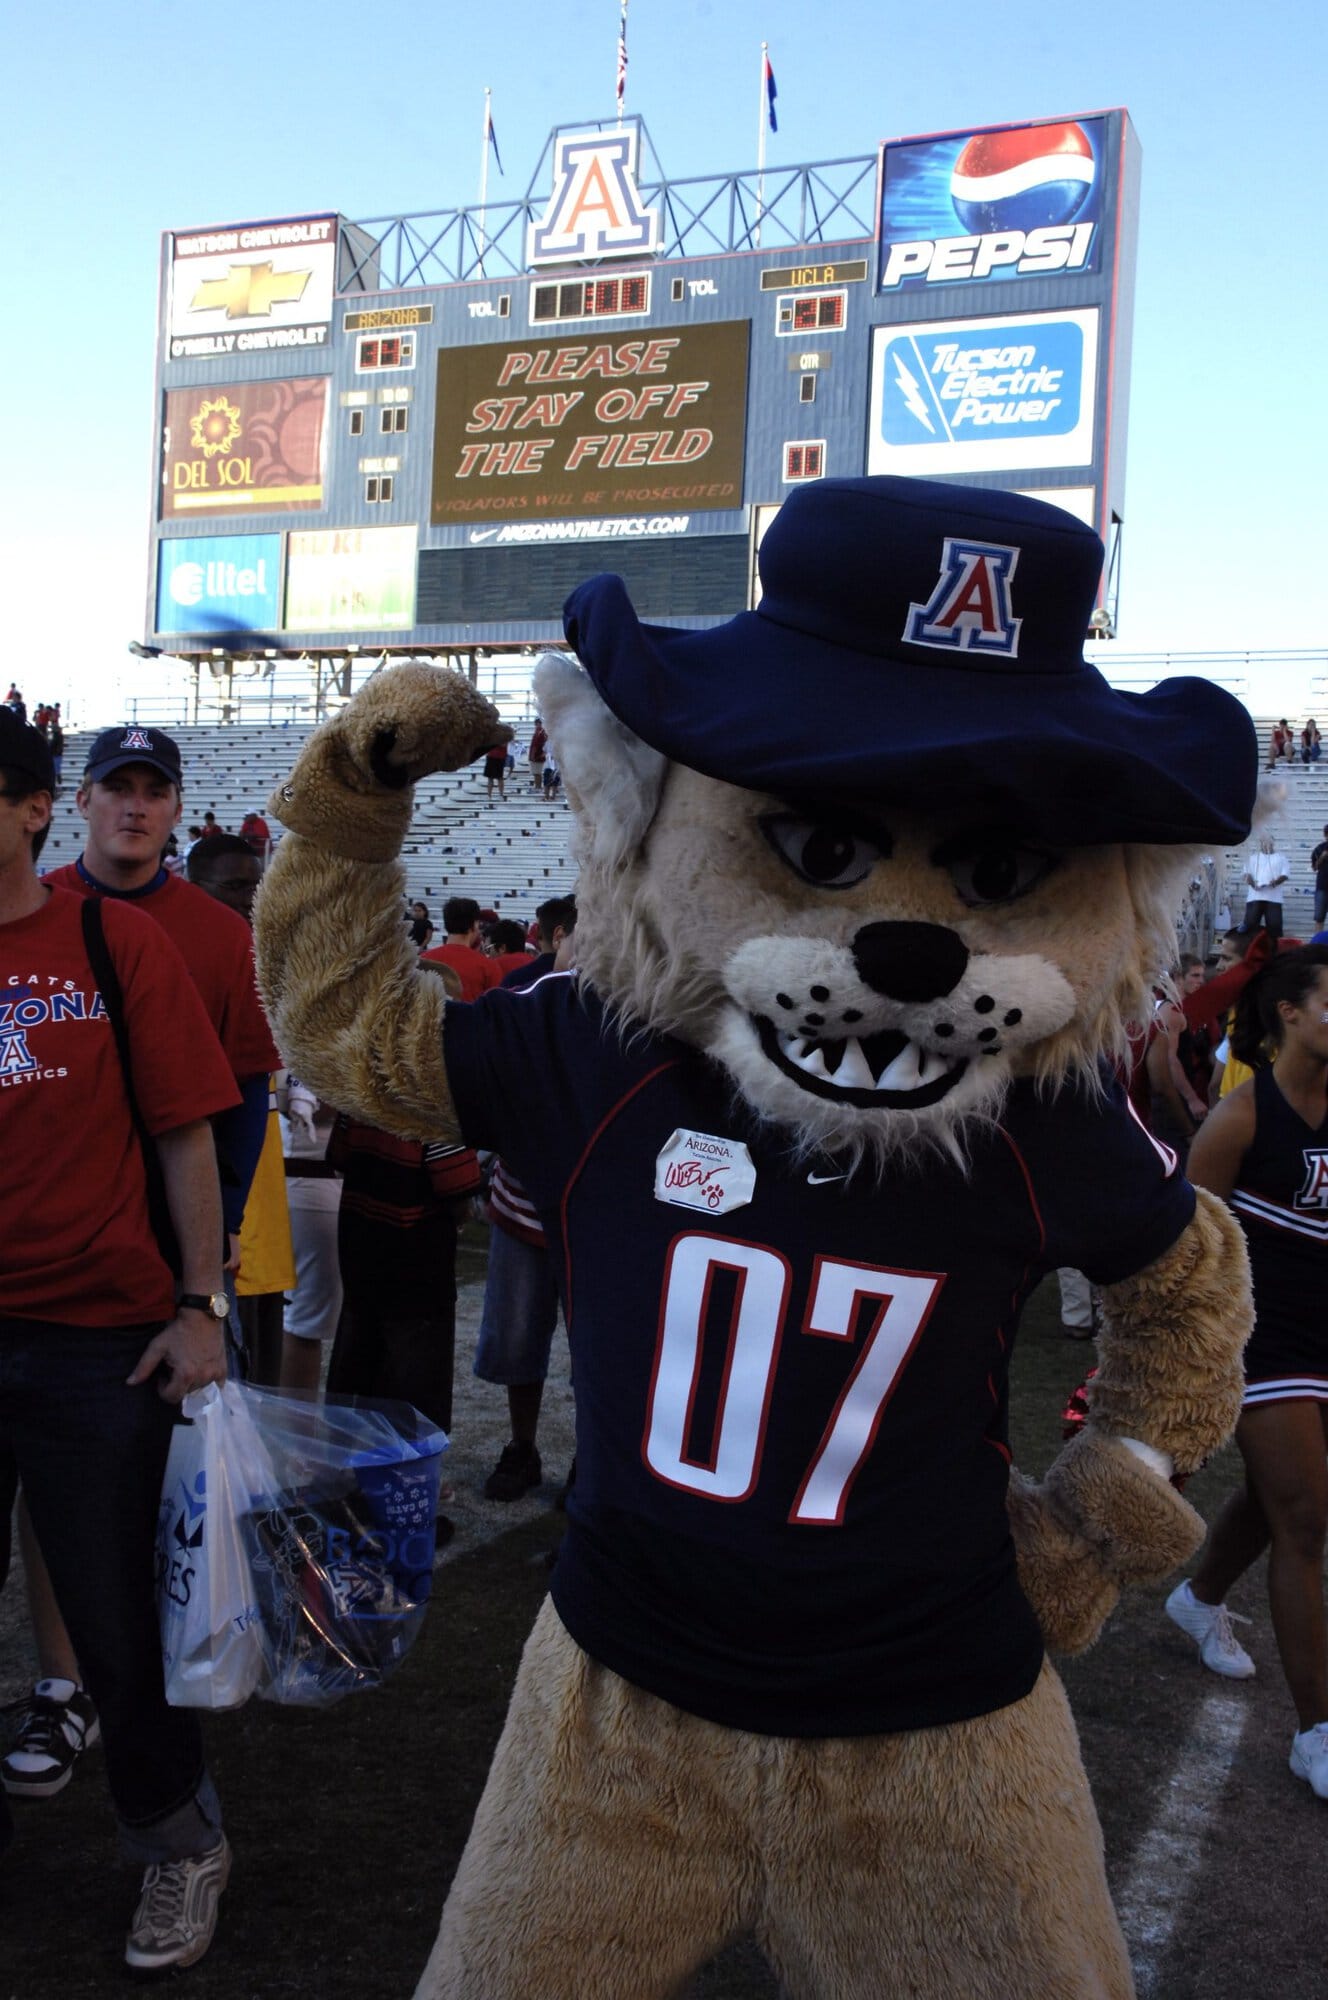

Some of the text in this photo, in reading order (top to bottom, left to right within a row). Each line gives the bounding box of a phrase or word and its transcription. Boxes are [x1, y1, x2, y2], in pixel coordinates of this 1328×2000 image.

[526, 128, 657, 265] A
[240, 222, 331, 248] CHEVROLET
[882, 222, 1097, 287] PEPSI
[791, 265, 834, 286] UCLA
[359, 308, 419, 328] ARIZONA
[237, 326, 327, 350] CHEVROLET
[497, 338, 680, 386] PLEASE
[932, 343, 1036, 374] Tucson
[940, 365, 1064, 399] Electric
[465, 381, 709, 433] STAY OFF
[950, 398, 1062, 427] Power
[455, 428, 713, 478] THE FIELD
[174, 457, 255, 489] DEL SOL
[435, 482, 735, 512] VIOLATORS WILL BE PROSECUTED
[901, 536, 1024, 658] A
[120, 729, 153, 750] A
[685, 1137, 730, 1158] ARIZONA
[641, 1229, 947, 1526] 07
